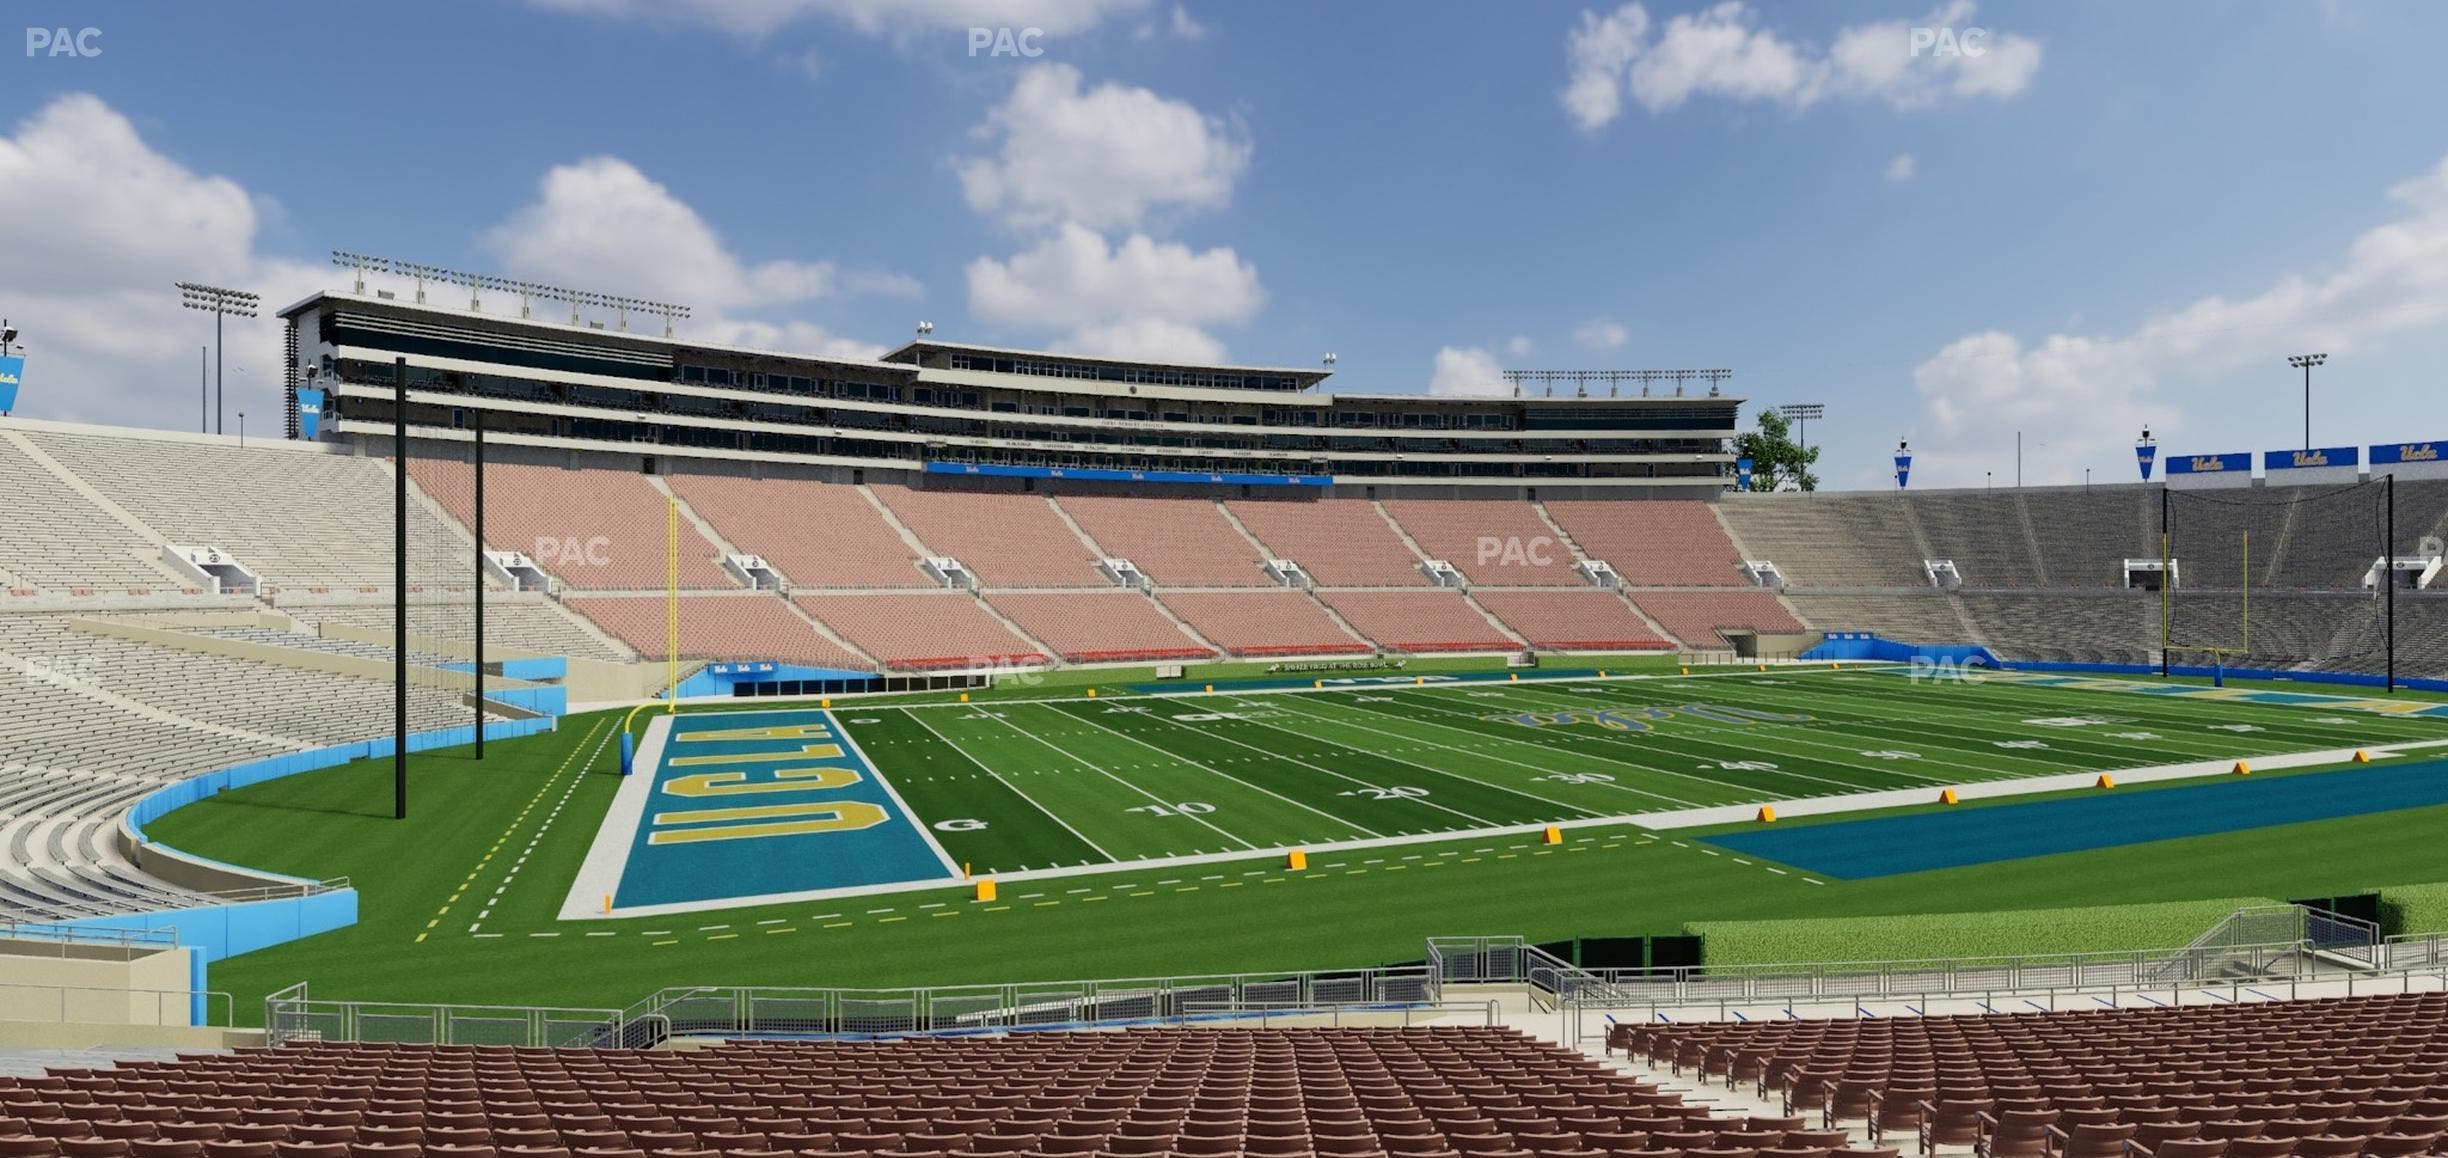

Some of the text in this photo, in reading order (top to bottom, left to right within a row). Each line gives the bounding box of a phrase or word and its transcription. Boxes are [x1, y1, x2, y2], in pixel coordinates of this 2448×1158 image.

[647, 723, 891, 845] UCLA
[1548, 772, 1616, 785] 30
[1357, 786, 1430, 800] 20
[1141, 802, 1217, 817] 10
[934, 818, 989, 832] G
